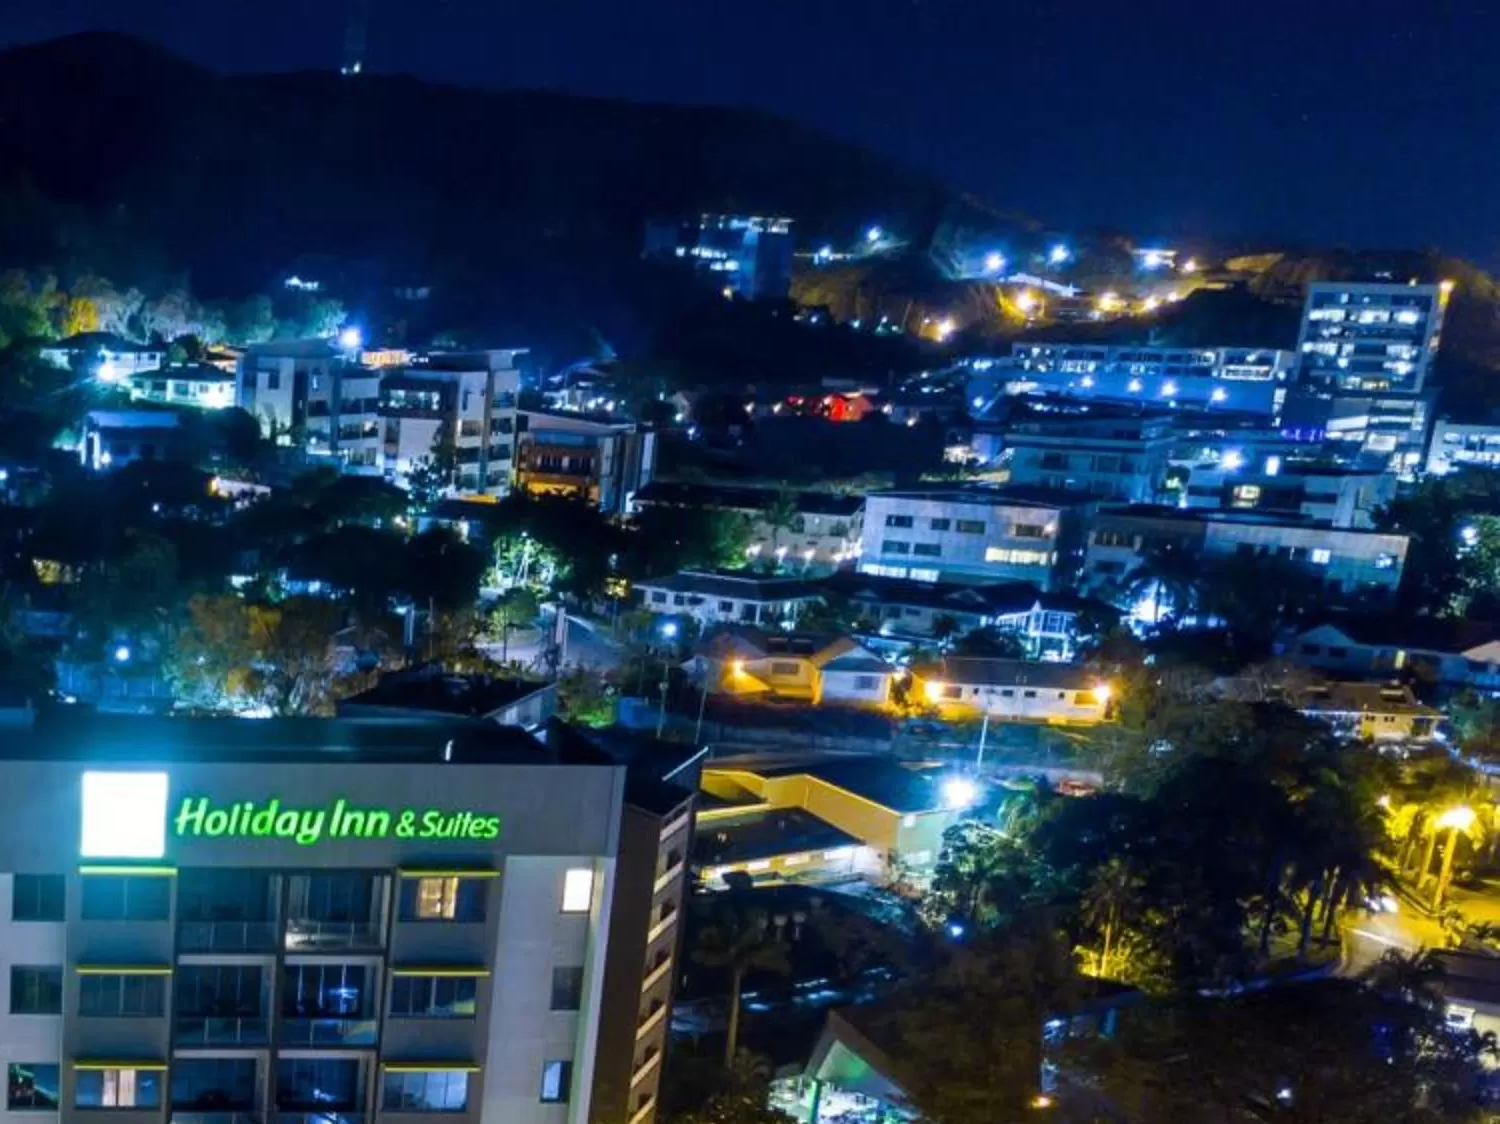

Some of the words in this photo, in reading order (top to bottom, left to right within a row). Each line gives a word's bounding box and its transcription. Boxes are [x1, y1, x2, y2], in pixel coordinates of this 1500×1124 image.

[174, 797, 325, 845] Holiday
[329, 799, 390, 837] Inn
[395, 810, 415, 837] &
[419, 810, 500, 838] Suites
